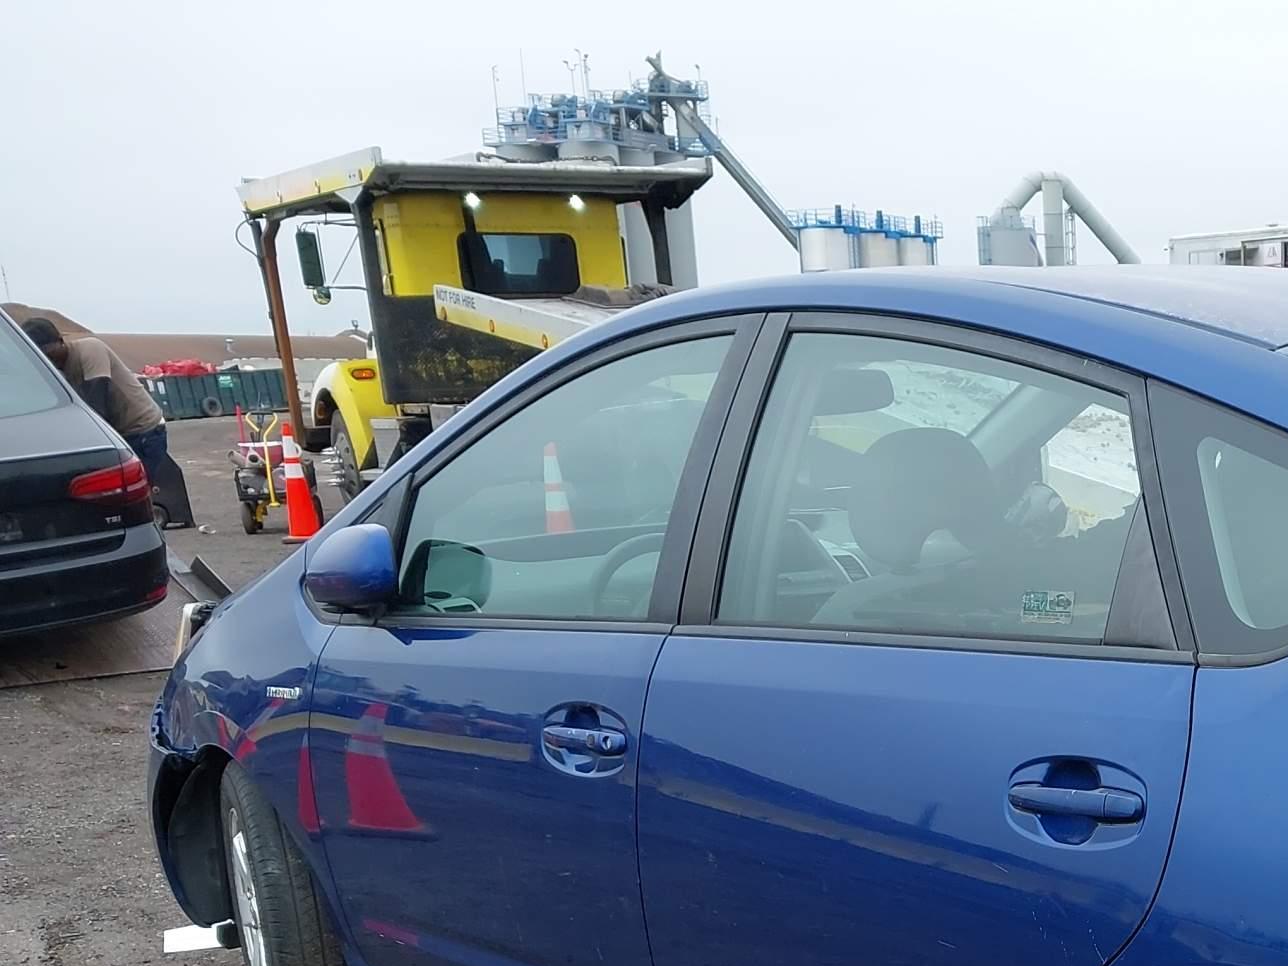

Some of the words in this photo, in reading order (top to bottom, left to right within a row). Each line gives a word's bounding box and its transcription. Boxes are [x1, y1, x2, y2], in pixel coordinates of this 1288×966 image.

[436, 286, 448, 303] NOT
[448, 291, 461, 305] FOR
[461, 293, 477, 310] HIRE
